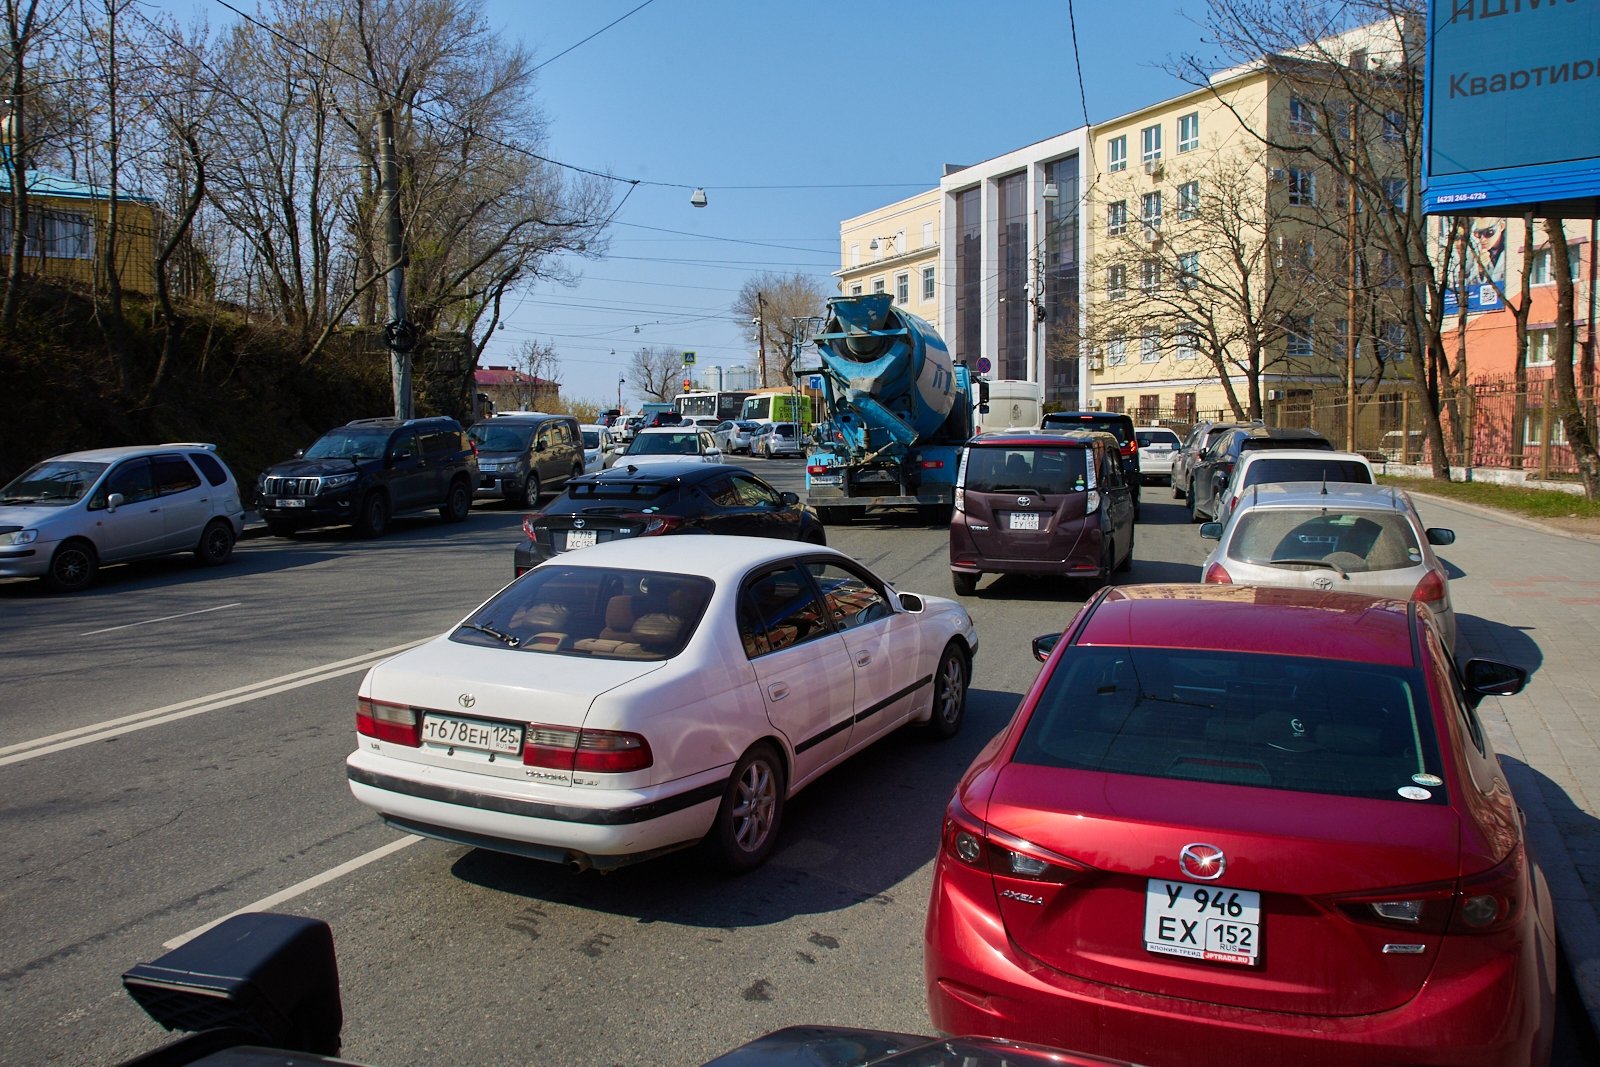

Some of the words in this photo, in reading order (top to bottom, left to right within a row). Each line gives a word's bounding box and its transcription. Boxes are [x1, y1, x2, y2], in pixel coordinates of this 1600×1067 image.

[1449, 58, 1600, 99] Квартир
[493, 726, 517, 744] 125
[1000, 889, 1044, 905] AXELA
[1193, 888, 1243, 917] 946
[1213, 924, 1252, 947] 152
[1219, 943, 1238, 953] RUS
[1205, 952, 1248, 964] JPTRADE.RU
